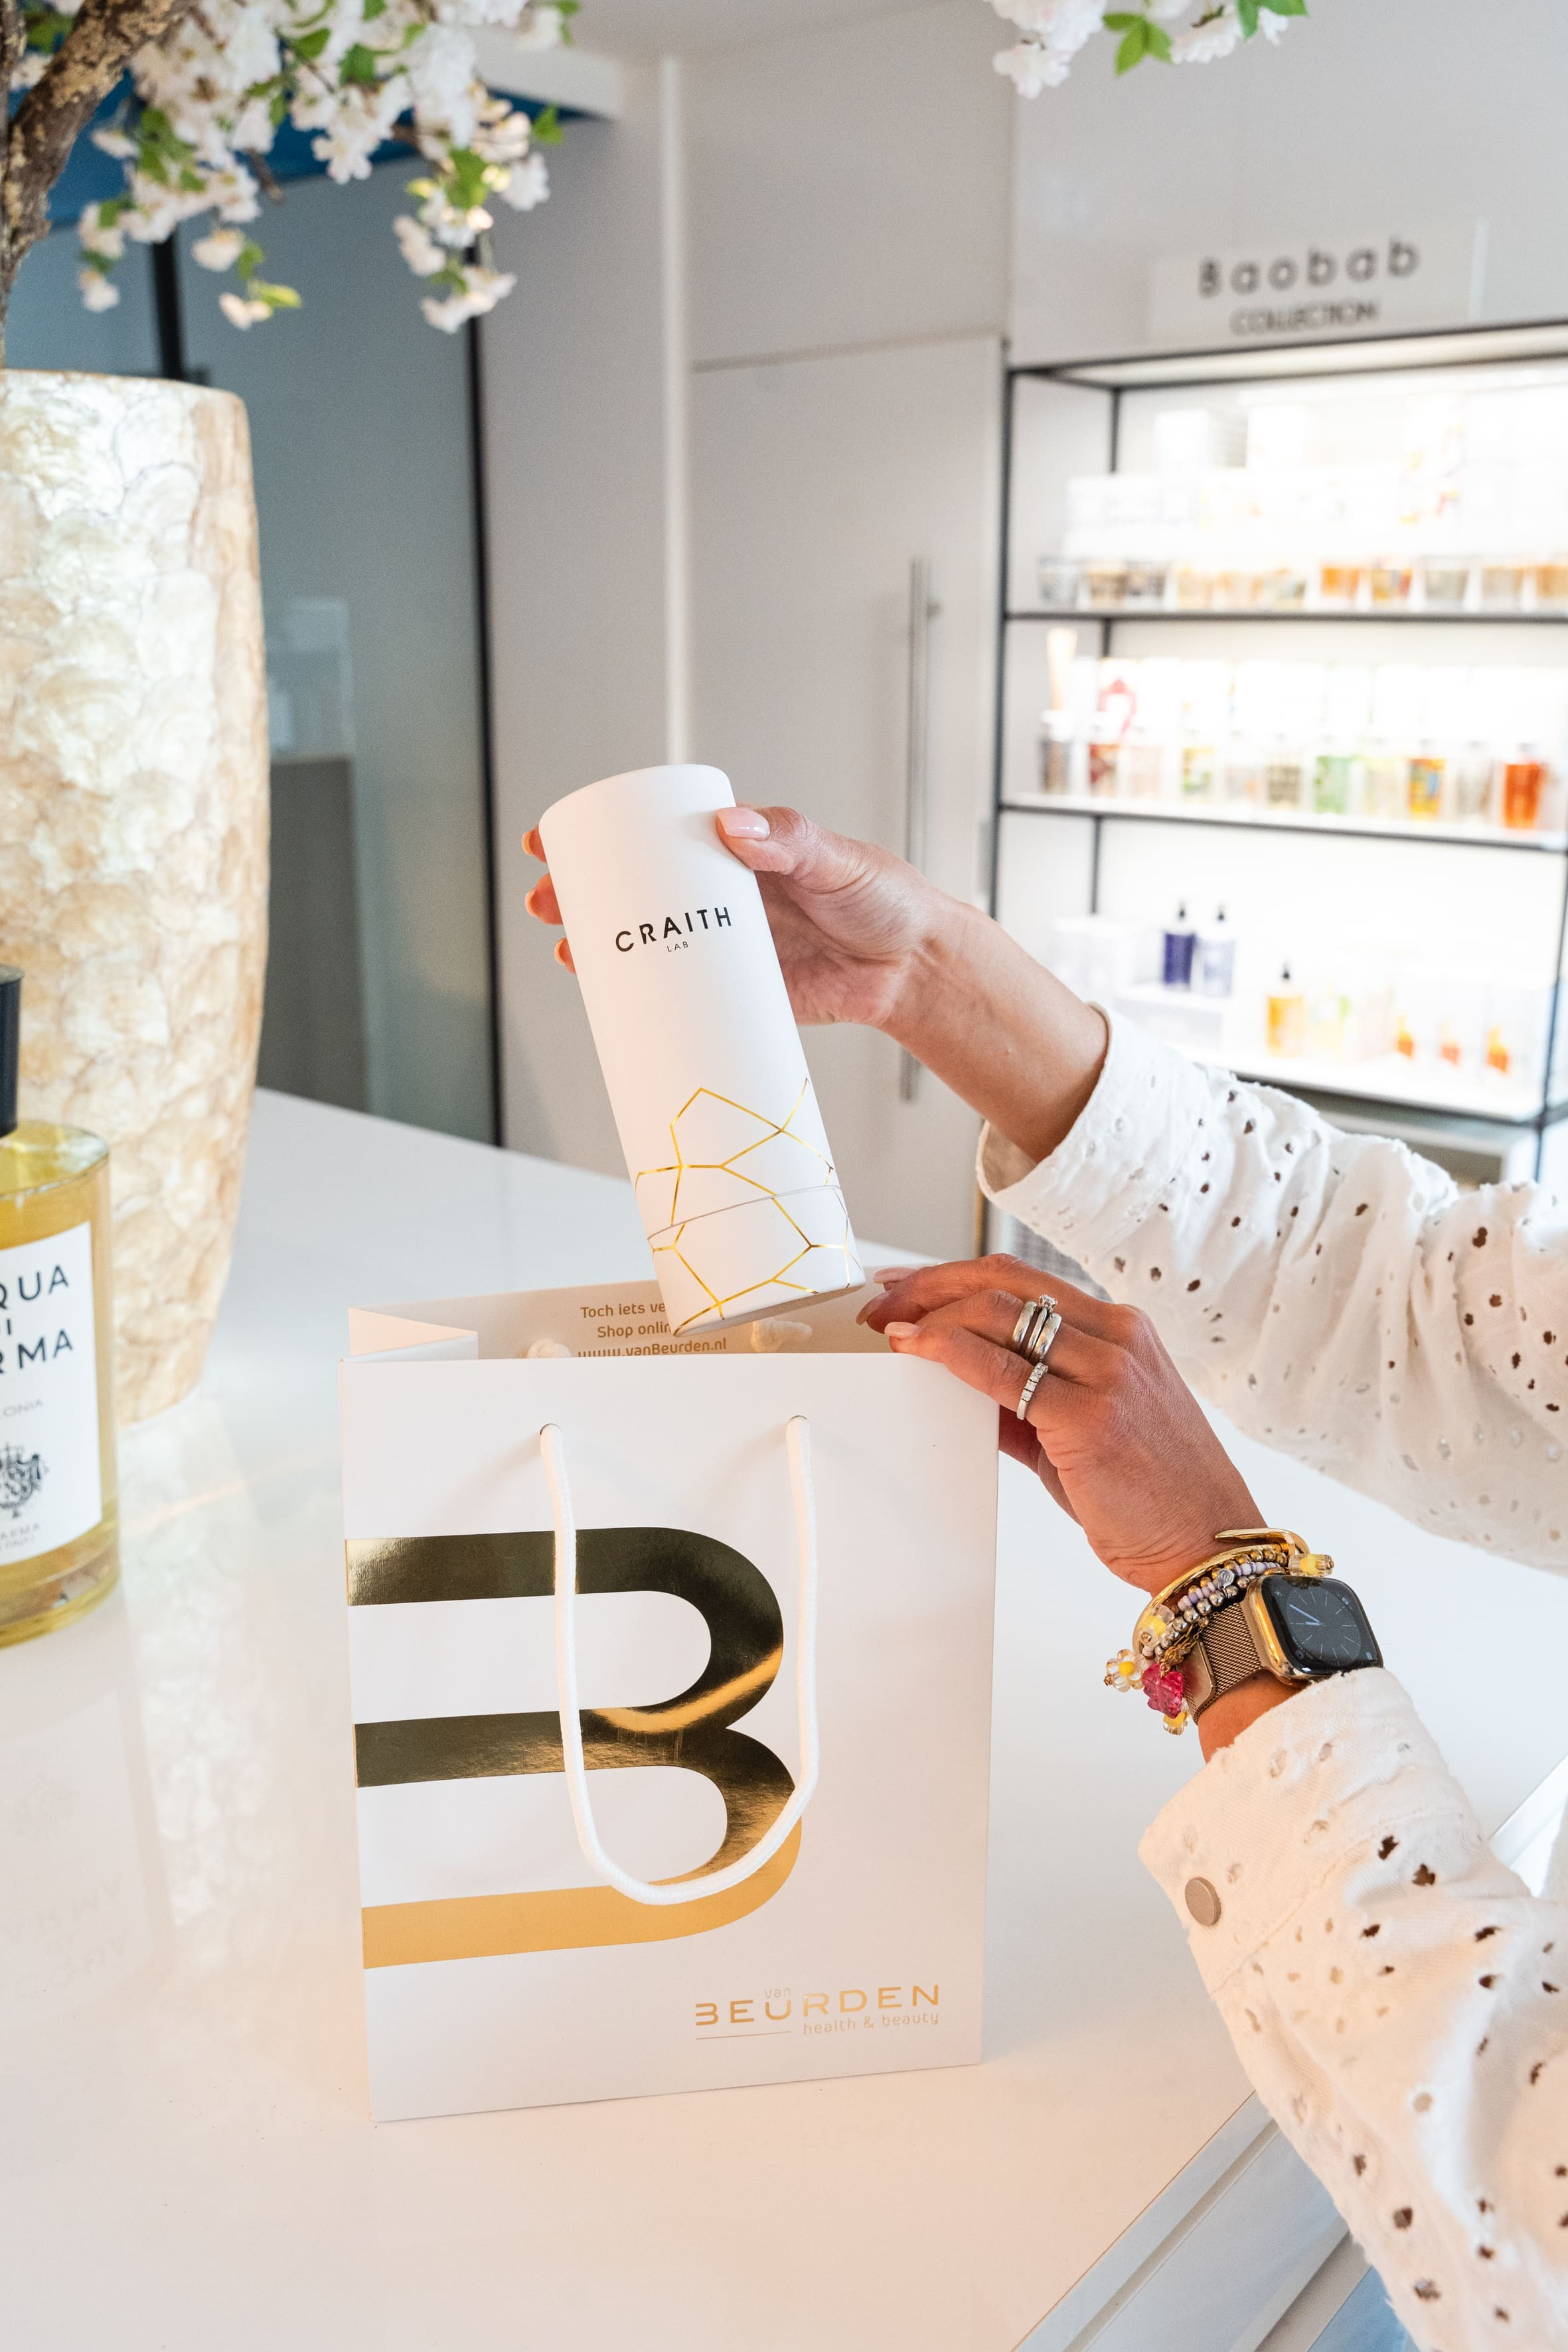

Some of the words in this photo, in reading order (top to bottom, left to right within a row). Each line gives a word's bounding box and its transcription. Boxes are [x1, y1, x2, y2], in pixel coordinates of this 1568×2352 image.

[1198, 235, 1419, 298] Baobab
[615, 907, 732, 952] CRAITH
[666, 941, 688, 952] LAB
[580, 1304, 614, 1318] Toch
[619, 1303, 645, 1315] iets
[597, 1325, 633, 1339] Shop
[0, 1330, 73, 1374] MA
[695, 1984, 939, 2026] BEURDEN
[765, 1987, 791, 1999] van
[803, 2016, 855, 2035] health
[864, 2015, 874, 2029] &
[882, 2011, 939, 2027] beauty
